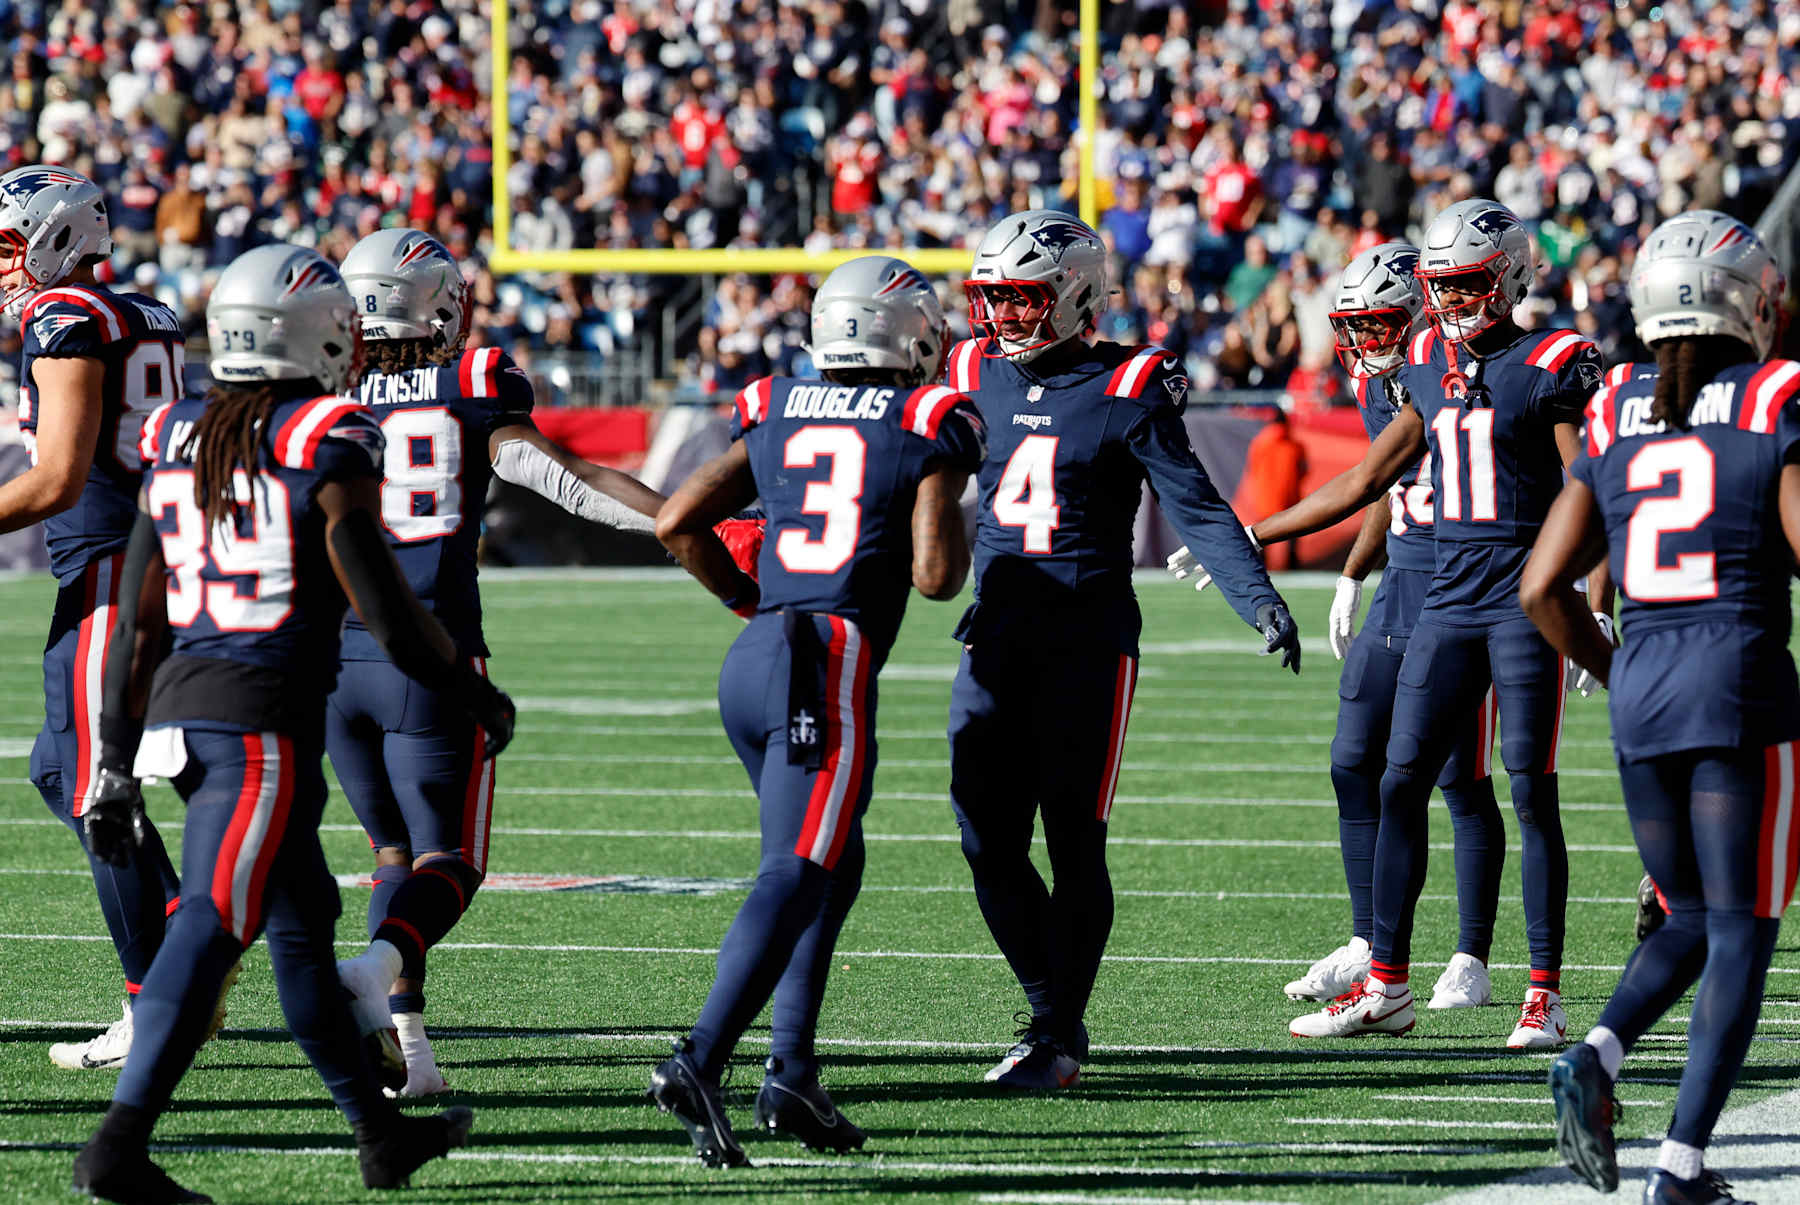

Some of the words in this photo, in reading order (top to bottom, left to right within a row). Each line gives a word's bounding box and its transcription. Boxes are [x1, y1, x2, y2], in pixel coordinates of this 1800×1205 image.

[366, 294, 378, 312] 8
[846, 318, 858, 337] 3
[1679, 284, 1693, 305] 2
[113, 339, 184, 474] 8
[344, 366, 439, 406] VENSON
[783, 385, 895, 420] DOUGLAS
[1012, 414, 1053, 431] PATRIOTS
[1618, 381, 1736, 437] OSRN
[378, 406, 464, 542] 8
[776, 425, 867, 574] 3
[992, 434, 1061, 554] 4
[1431, 407, 1498, 521] 11
[149, 468, 296, 632] 39
[1623, 435, 1719, 603] 2
